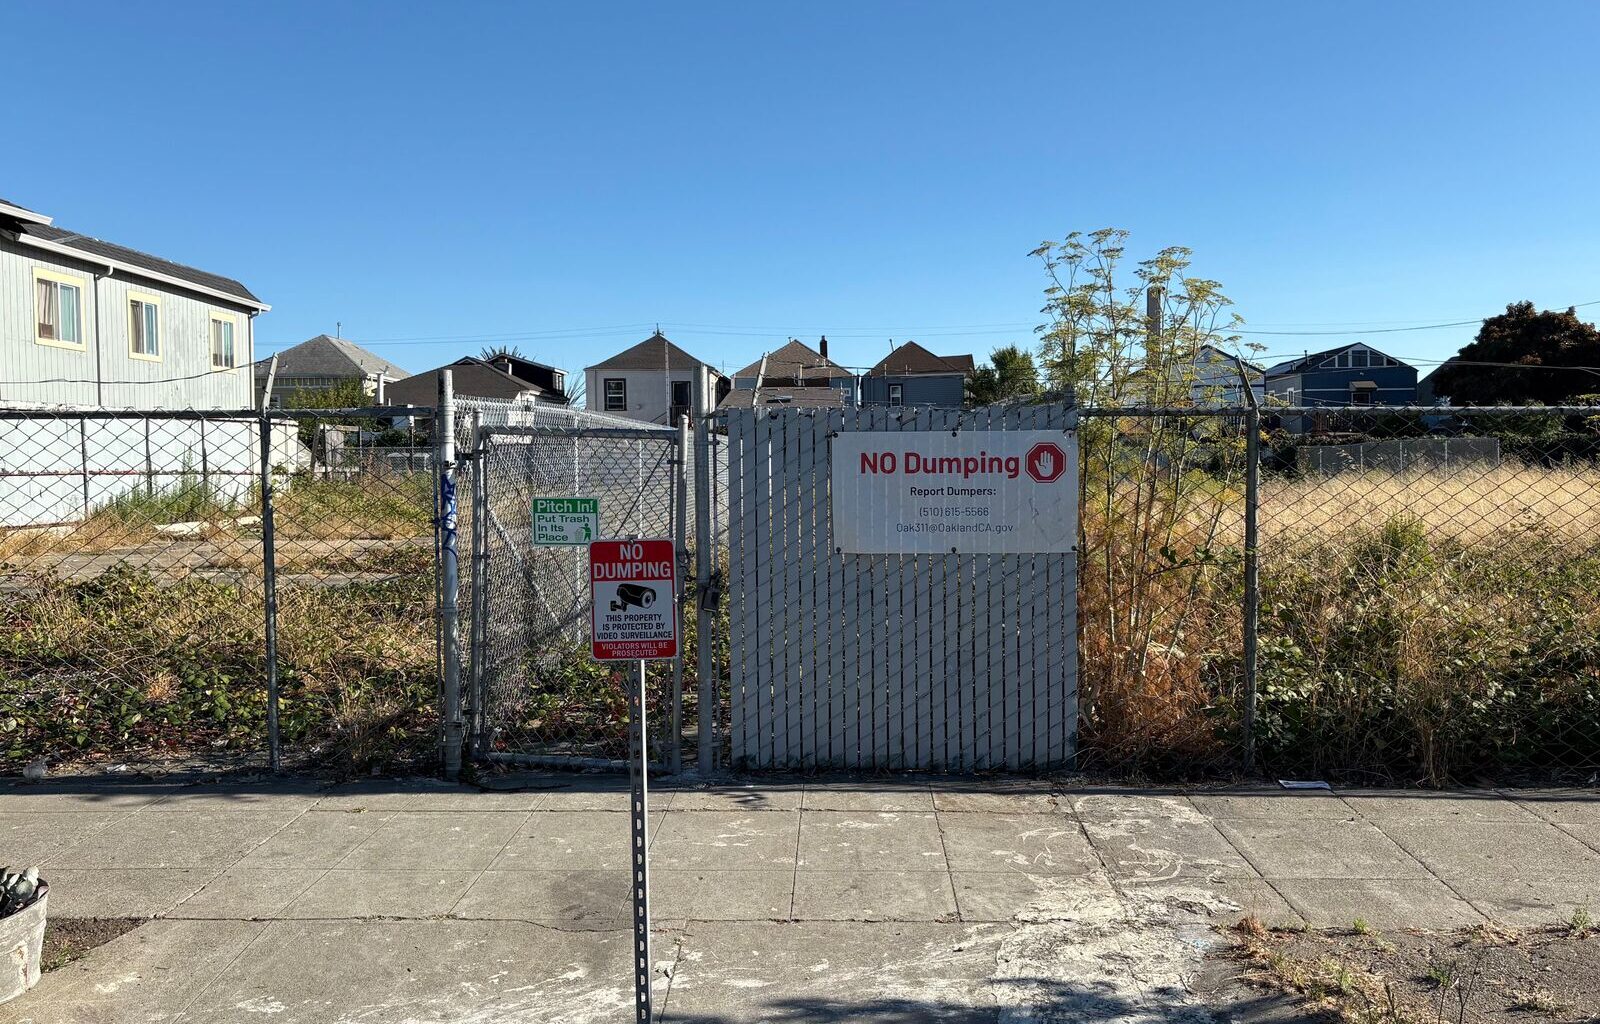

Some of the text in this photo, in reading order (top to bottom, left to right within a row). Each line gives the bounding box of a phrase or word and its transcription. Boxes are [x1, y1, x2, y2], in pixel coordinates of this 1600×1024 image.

[860, 451, 1020, 479] NO Dumping
[910, 486, 997, 498] Report Dumpers:
[538, 500, 593, 513] Pitch In!
[537, 515, 590, 523] Put Trash
[896, 523, 1014, 534] Oak311@OaklandCA.gov
[538, 533, 568, 541] Place
[619, 544, 644, 560] NO
[593, 562, 672, 579] DUMPING
[605, 613, 662, 622] THIS PROPERTY
[596, 631, 673, 640] VIDEO SURVEILLANCE
[601, 642, 640, 650] VIOLATORS
[658, 641, 668, 649] BE
[612, 649, 658, 657] PROSECUTED
